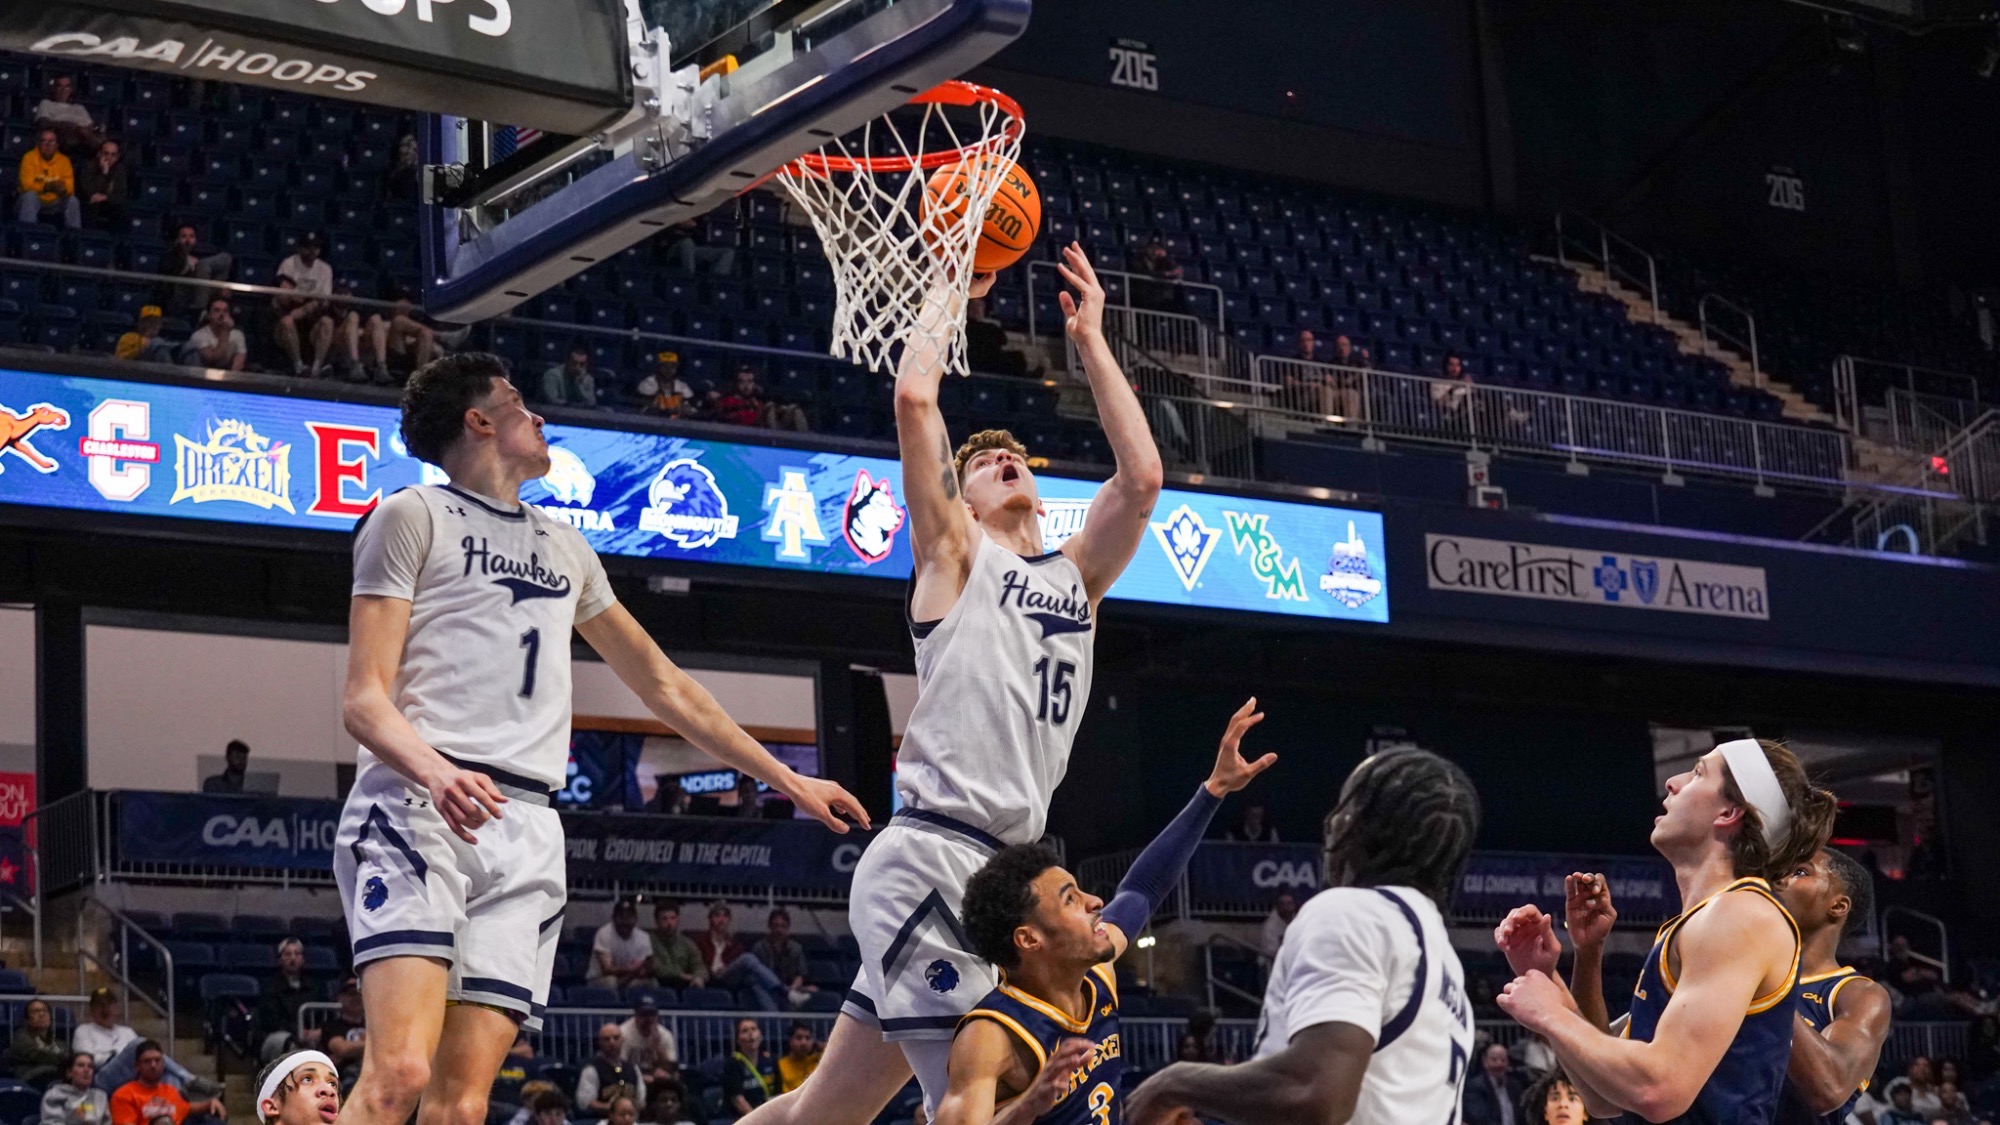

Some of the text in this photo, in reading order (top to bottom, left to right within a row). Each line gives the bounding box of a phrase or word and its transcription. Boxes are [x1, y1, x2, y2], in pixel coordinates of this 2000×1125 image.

[29, 32, 378, 92] CAA HOOPS
[1108, 47, 1158, 91] 205
[1765, 174, 1804, 210] 206
[182, 447, 285, 498] DREXEL
[304, 421, 383, 519] E
[461, 536, 564, 588] Hawks
[1430, 538, 1765, 615] CareFirst Arena
[518, 626, 541, 700] 1
[1032, 655, 1076, 727] 15
[202, 814, 290, 848] CAA
[603, 839, 675, 864] CROWNED
[679, 842, 696, 864] IN
[696, 843, 722, 864] THE
[721, 844, 772, 867] CAPITAL
[1252, 861, 1317, 888] CAA
